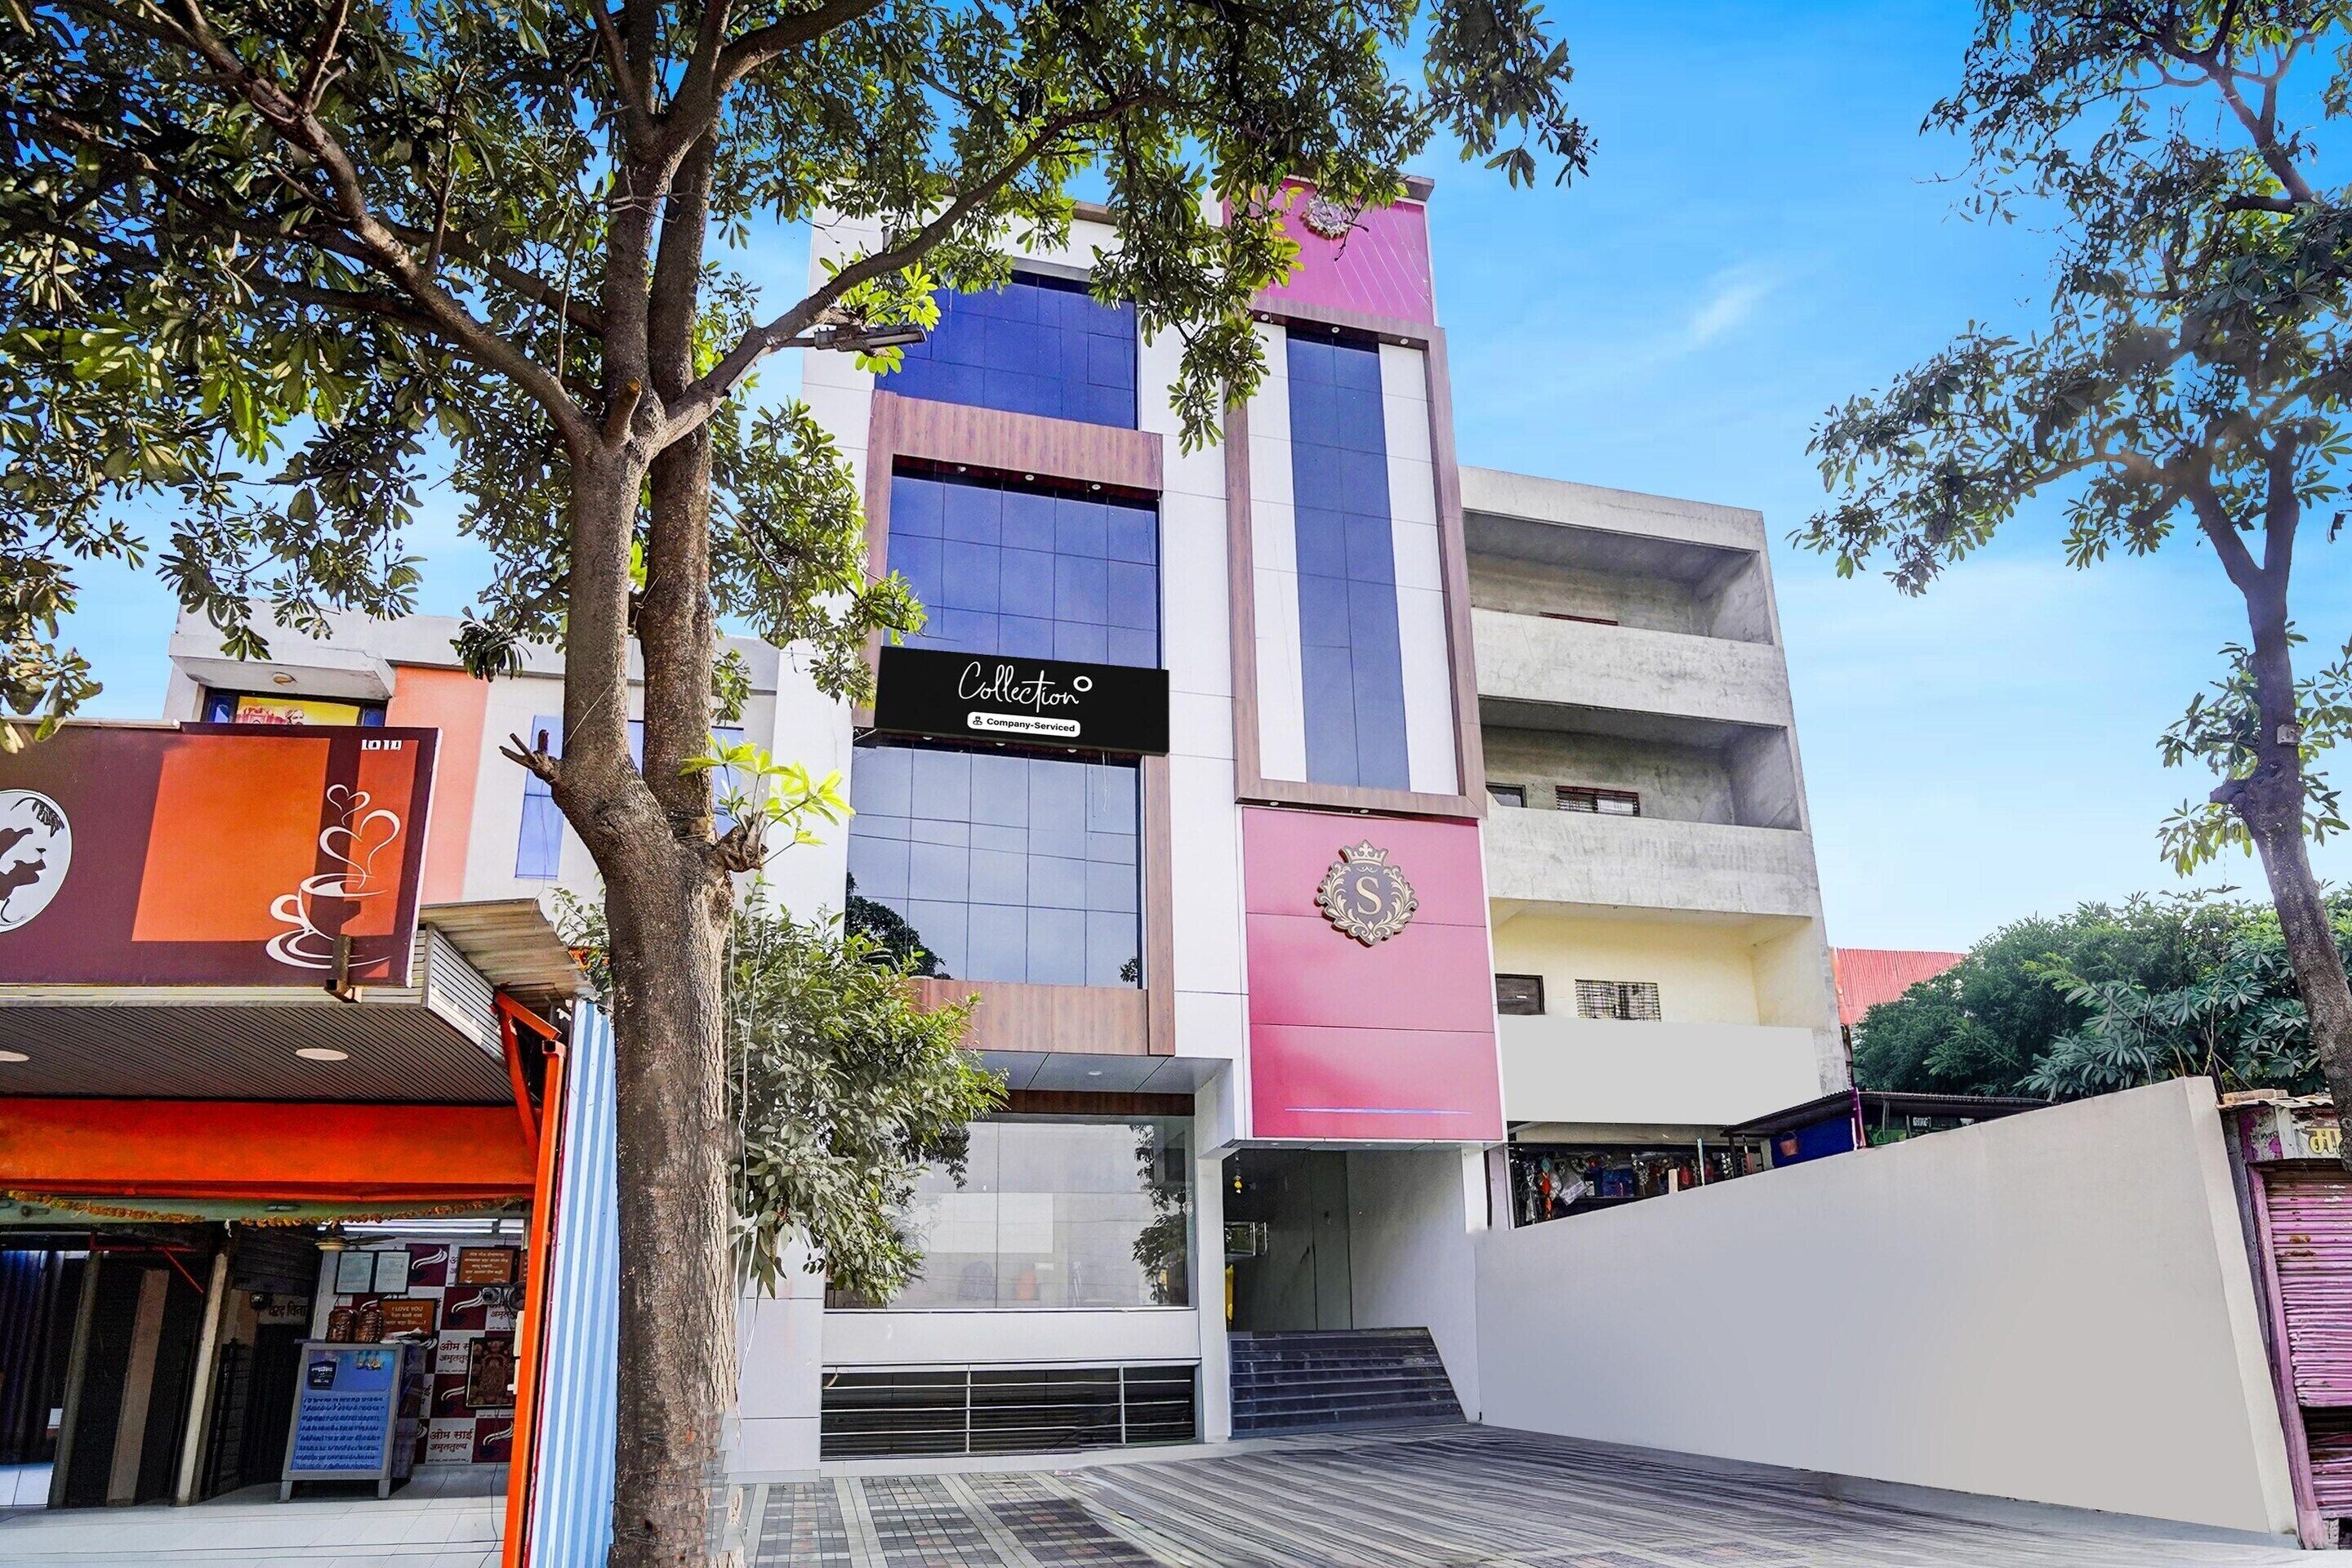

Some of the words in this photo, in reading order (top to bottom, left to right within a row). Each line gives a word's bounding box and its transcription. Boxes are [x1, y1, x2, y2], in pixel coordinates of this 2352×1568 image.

[958, 661, 1080, 713] Collection
[987, 718, 1076, 733] Company-Serviced
[1355, 876, 1382, 915] S
[430, 1428, 451, 1439] ओम
[454, 1428, 474, 1440] साई
[430, 1443, 467, 1452] अमृततुल्य
